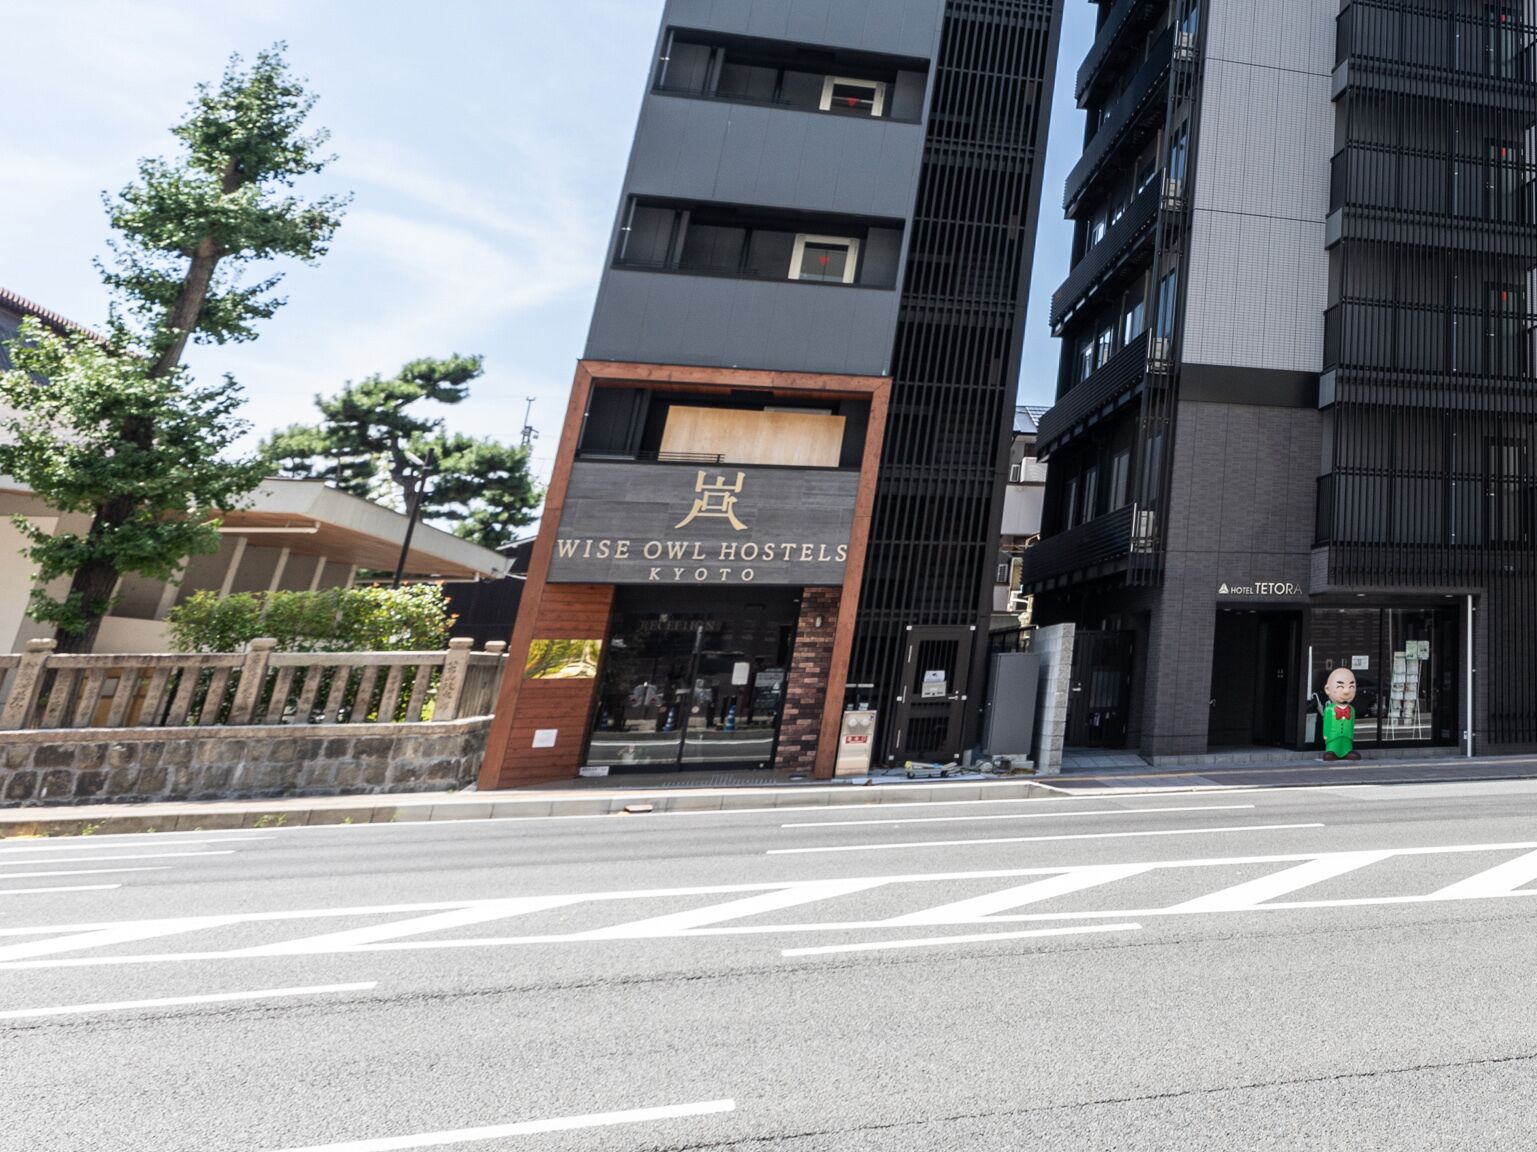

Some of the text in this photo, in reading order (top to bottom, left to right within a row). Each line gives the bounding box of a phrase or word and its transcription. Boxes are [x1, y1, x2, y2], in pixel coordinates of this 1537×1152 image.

[557, 539, 848, 562] WISE OWL HOSTELS
[648, 567, 755, 581] KYOTO
[1230, 582, 1303, 595] HOTEL TETORA
